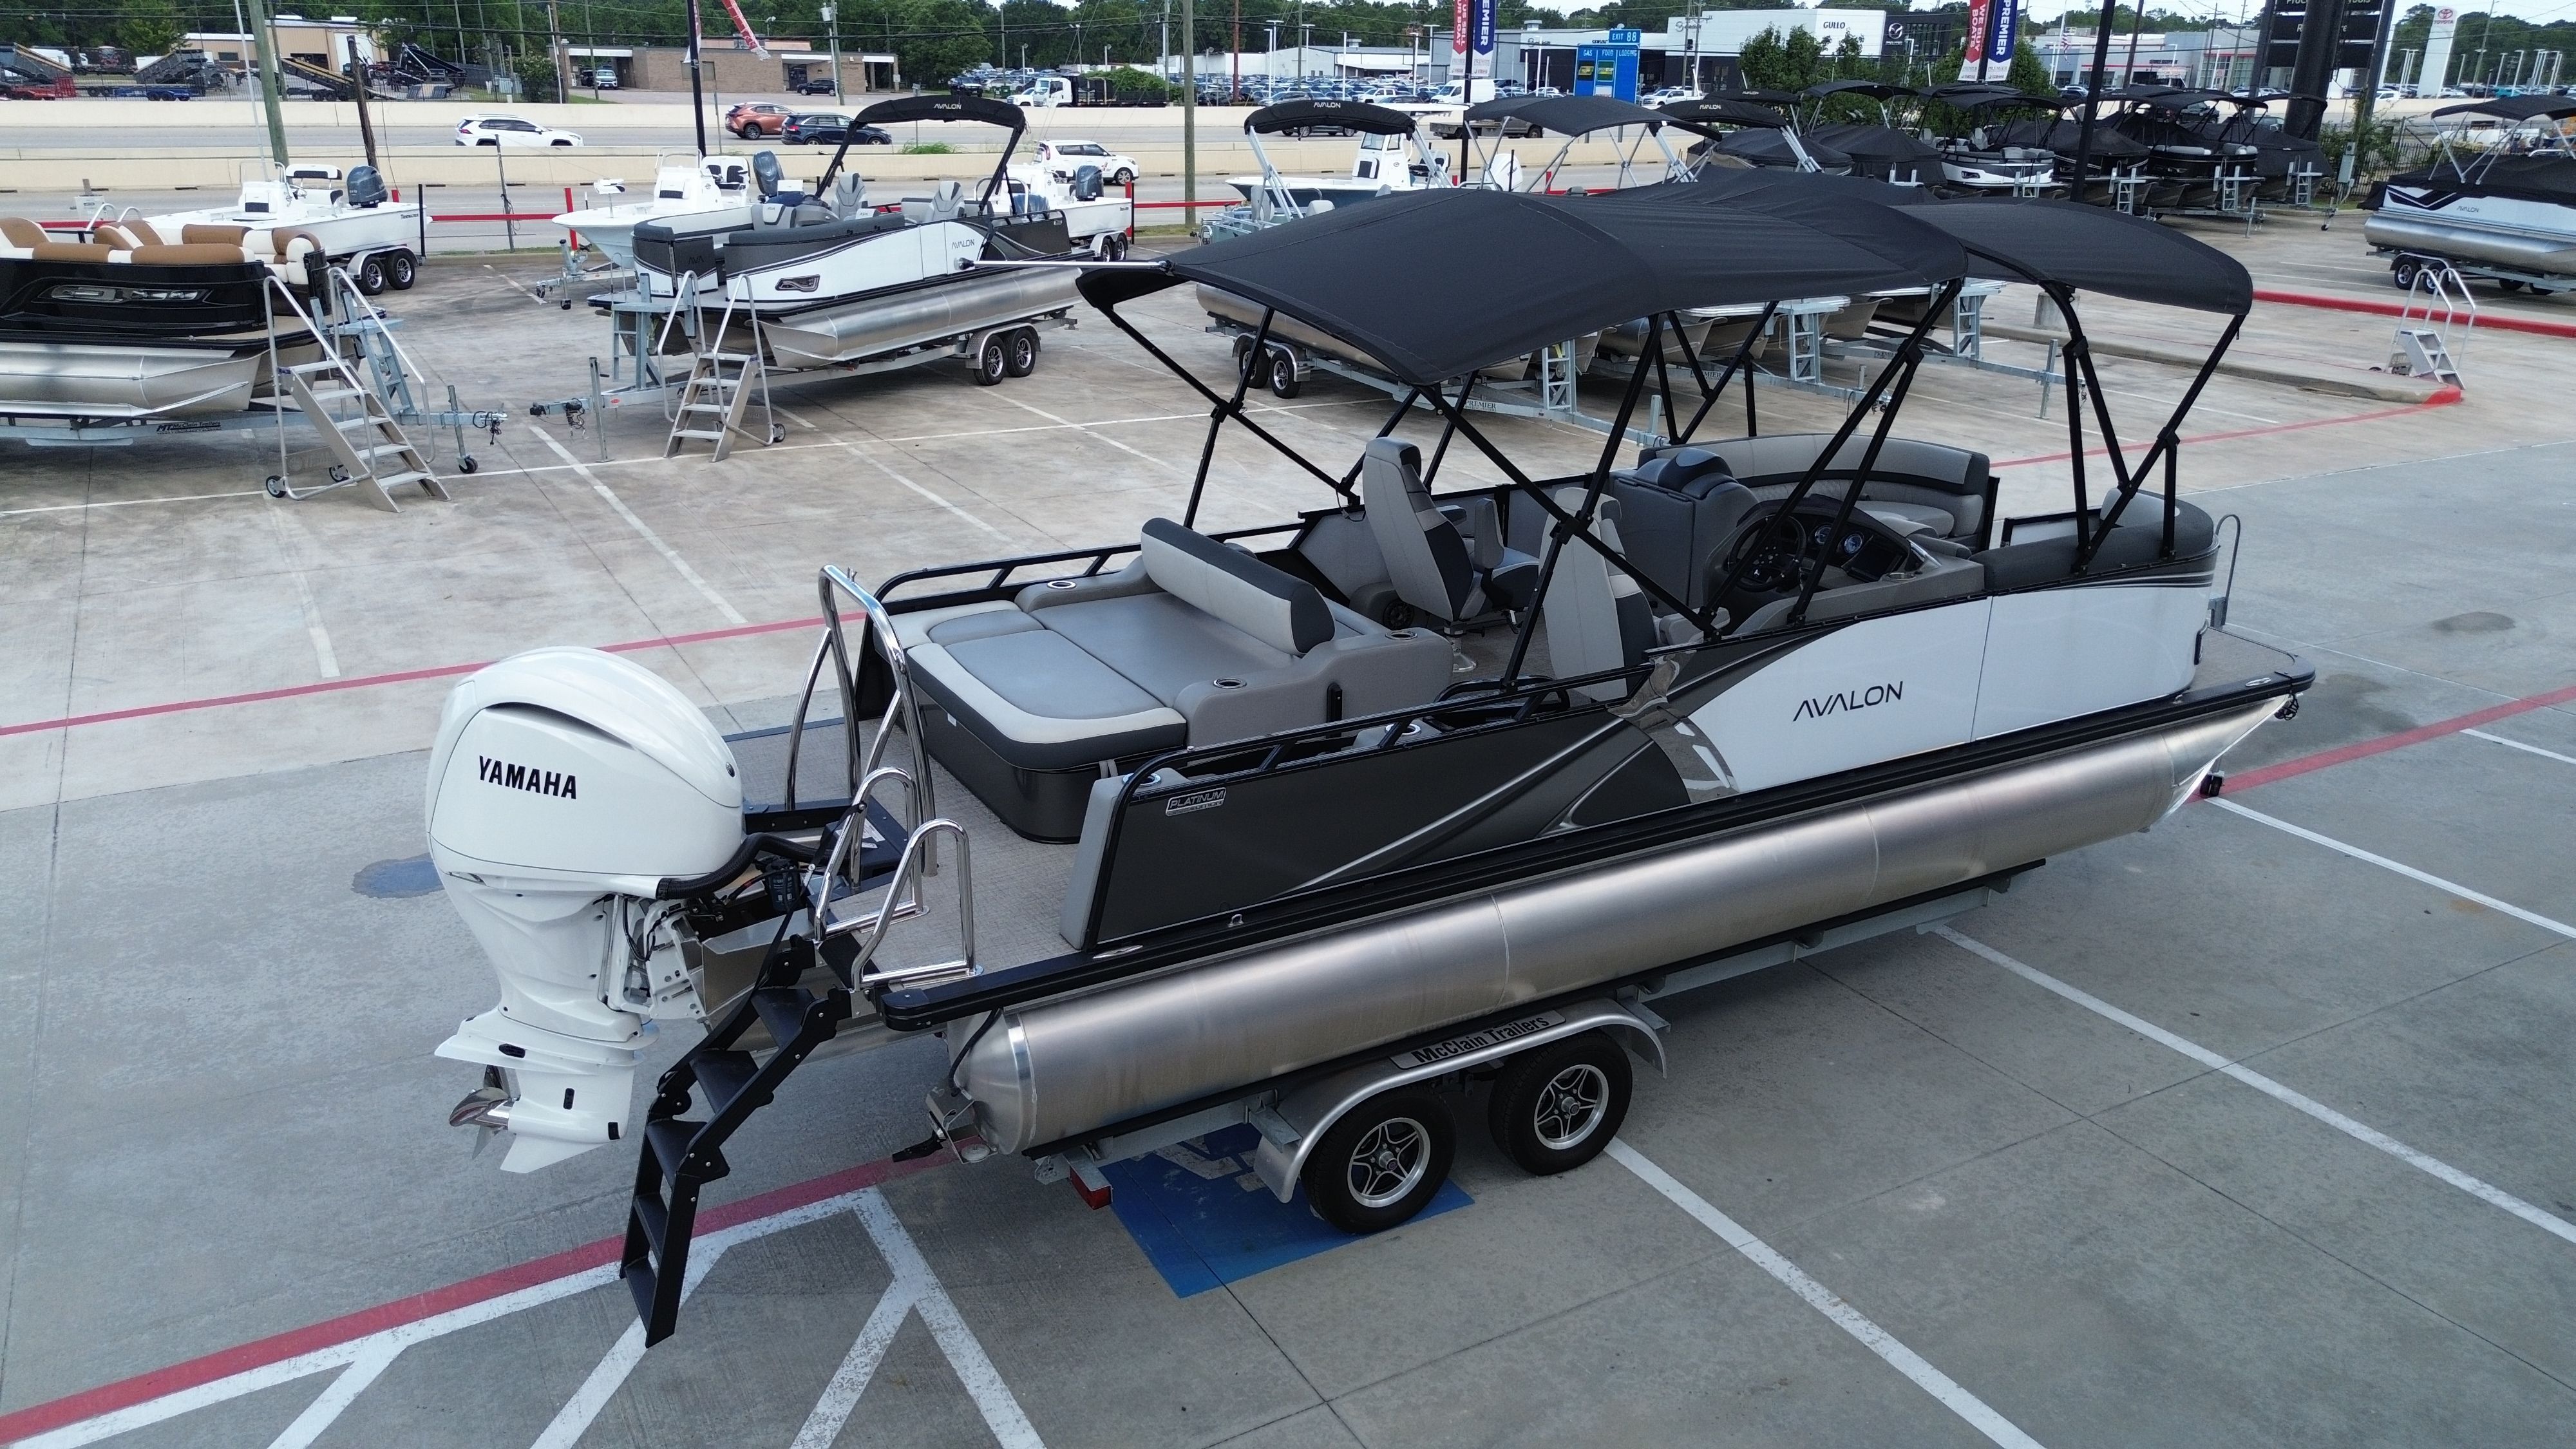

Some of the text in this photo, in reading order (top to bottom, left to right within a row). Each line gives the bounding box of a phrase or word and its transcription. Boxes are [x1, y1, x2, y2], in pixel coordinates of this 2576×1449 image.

[1481, 0, 1490, 46] EMIER
[1971, 9, 1979, 48] BOATS
[1978, 4, 1986, 24] WE
[1996, 0, 2012, 55] PREMIER
[1626, 32, 1637, 42] 88
[951, 238, 975, 250] AVALON
[1793, 681, 1903, 722] AVALON
[479, 755, 577, 799] YAMAHA
[1170, 790, 1224, 809] PLATINUM
[1410, 1017, 1549, 1063] McClain Trailers
